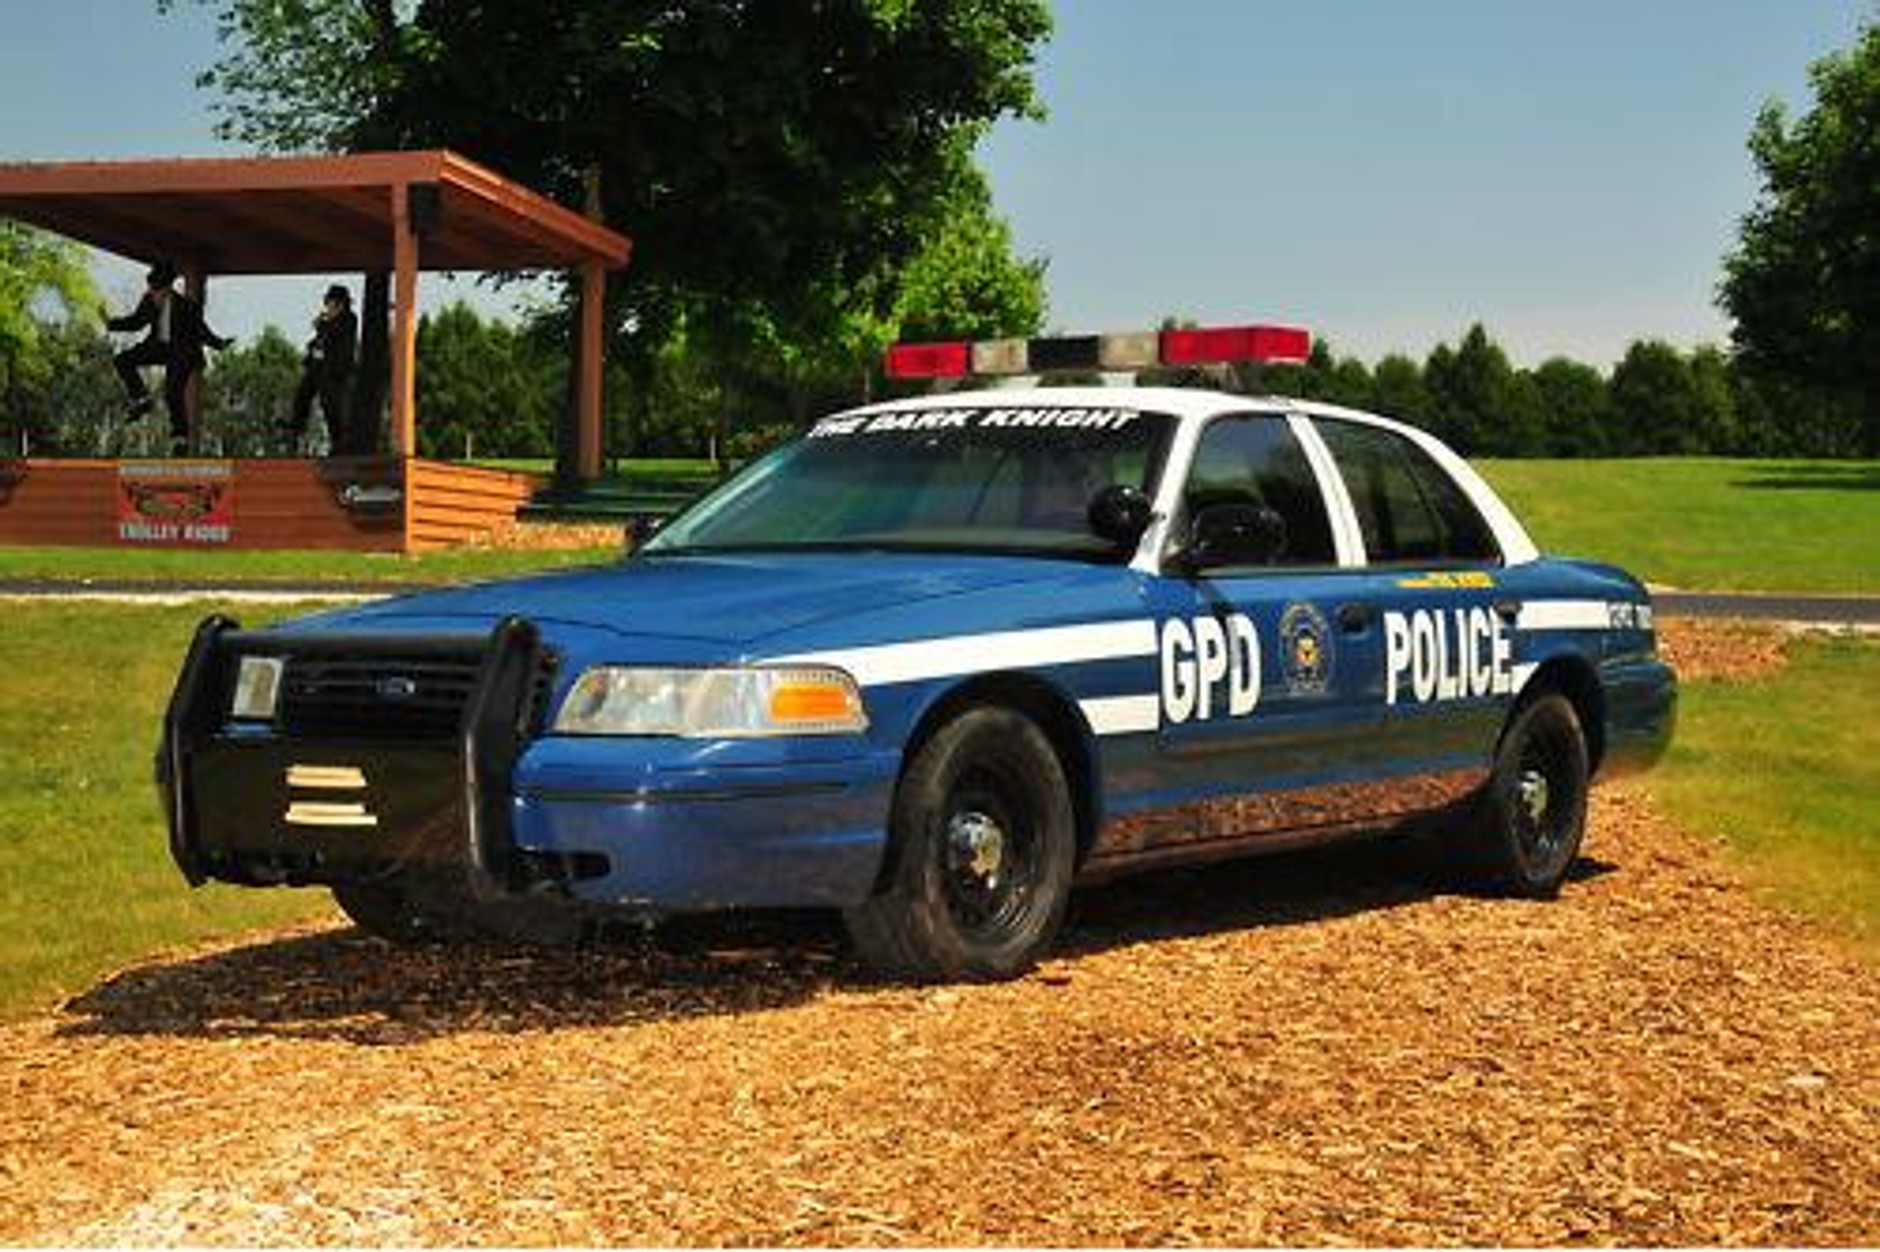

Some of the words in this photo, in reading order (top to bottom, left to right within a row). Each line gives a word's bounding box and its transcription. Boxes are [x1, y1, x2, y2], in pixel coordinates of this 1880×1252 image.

[864, 410, 979, 433] DARK
[980, 409, 1139, 430] KNIGHT
[1161, 612, 1262, 724] GPD
[1384, 606, 1512, 705] POLICE
